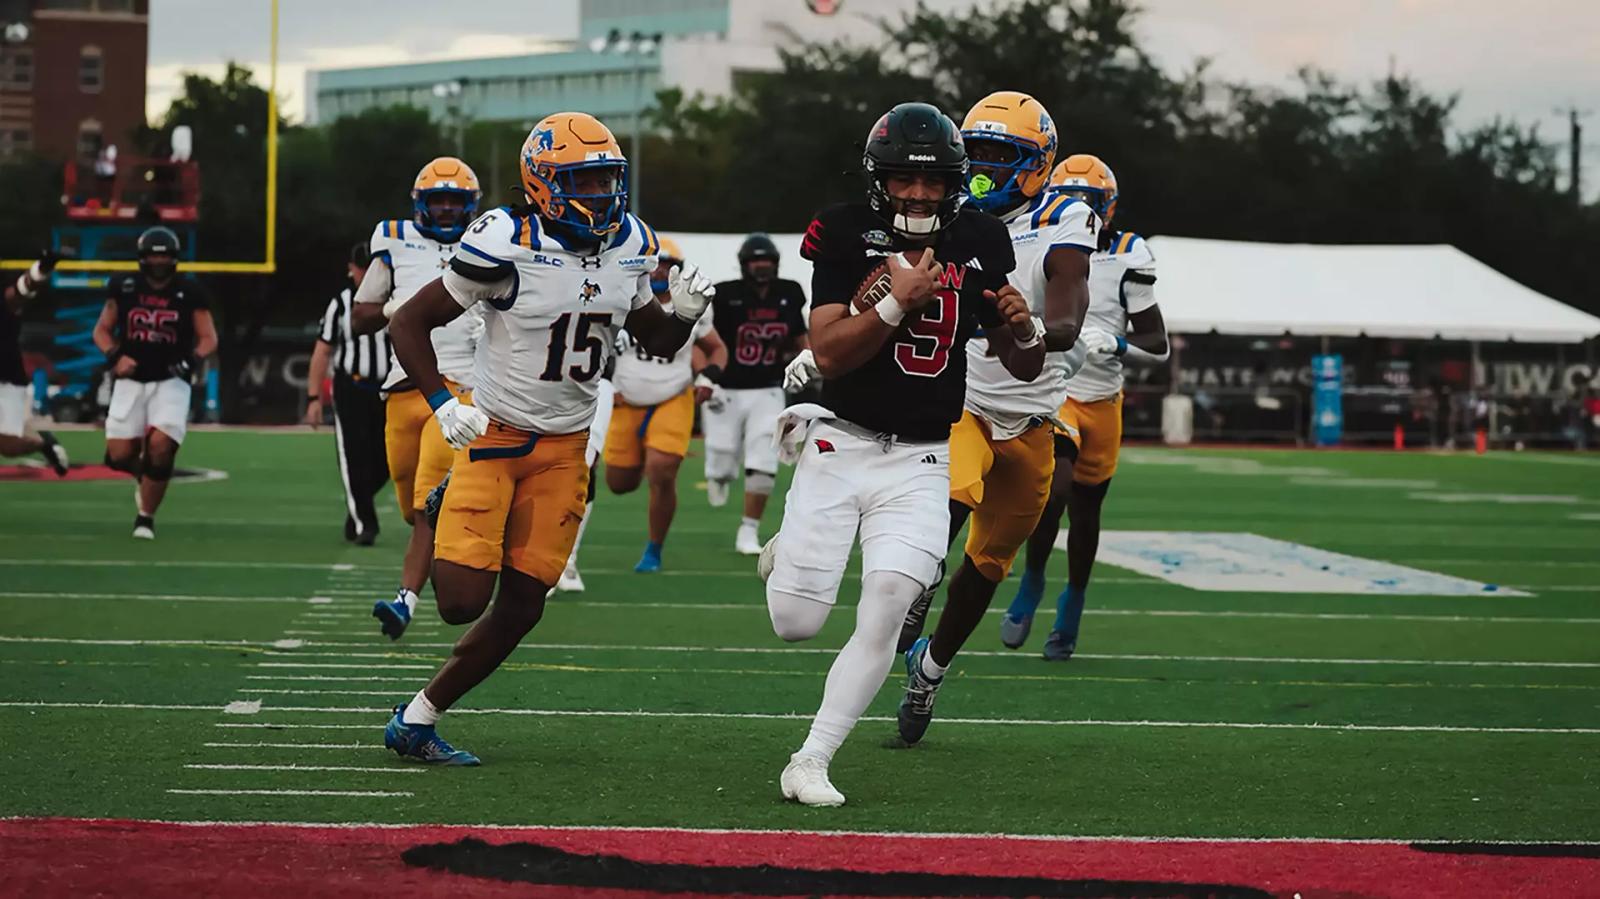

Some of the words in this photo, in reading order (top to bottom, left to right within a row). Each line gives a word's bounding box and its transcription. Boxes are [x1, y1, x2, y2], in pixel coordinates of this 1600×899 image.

[1085, 210, 1097, 236] 4
[937, 261, 967, 290] W
[128, 306, 179, 344] 65
[735, 322, 789, 366] 67
[894, 288, 960, 378] 9
[538, 311, 614, 383] 15
